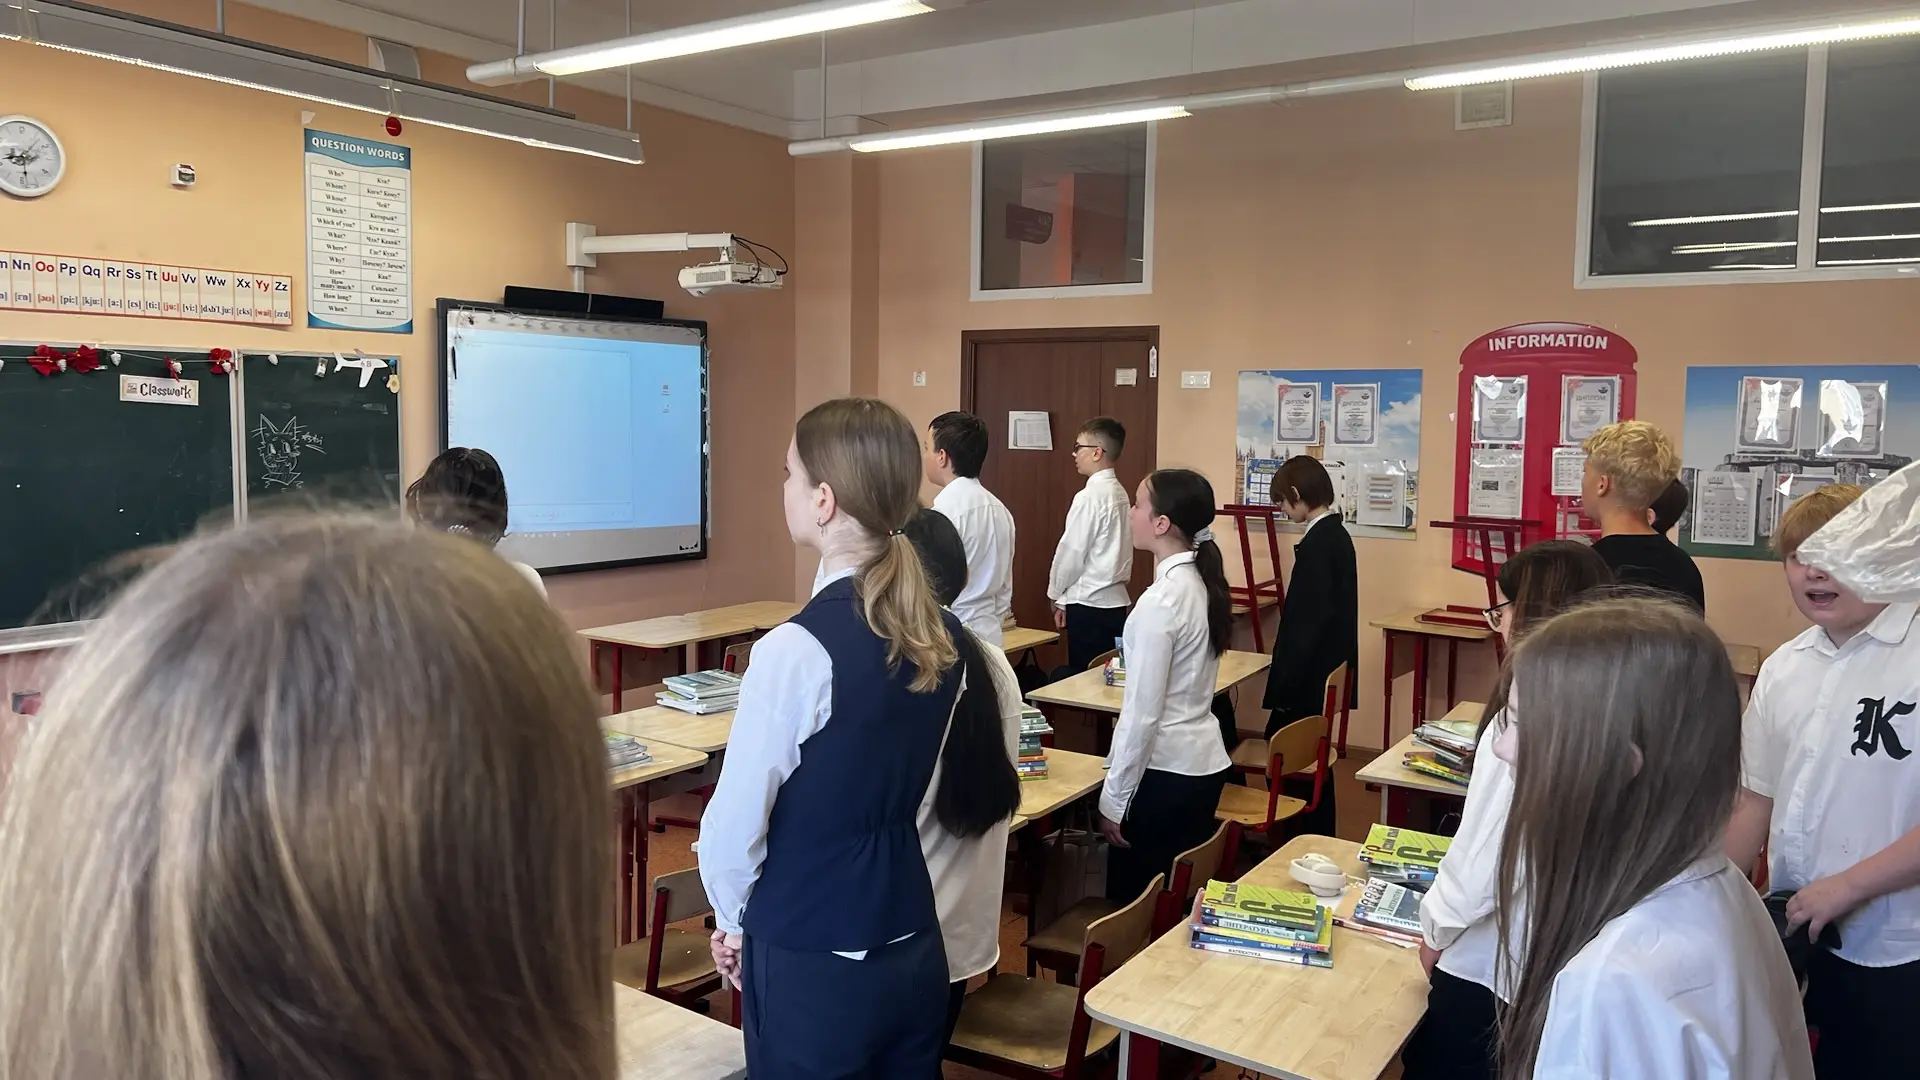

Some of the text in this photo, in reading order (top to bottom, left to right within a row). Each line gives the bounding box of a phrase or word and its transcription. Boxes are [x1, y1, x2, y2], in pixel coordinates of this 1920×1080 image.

[312, 137, 405, 161] QUESTION WORDS
[12, 259, 31, 271] Nn
[35, 261, 55, 273] Oo
[60, 262, 77, 276] Pp
[82, 265, 101, 279] Qq
[107, 266, 121, 278] Rr
[126, 269, 141, 280] Ss
[145, 270, 158, 281] Tt
[162, 271, 178, 282] Uu
[181, 273, 197, 284] Vv
[205, 275, 226, 286] Ww
[236, 278, 251, 289] Xx
[255, 279, 270, 292] Yy
[275, 281, 288, 292] Zz
[1488, 333, 1608, 351] INFORMATION
[140, 382, 192, 399] Classwork
[1850, 695, 1917, 761] K
[1224, 920, 1270, 934] ЛИТЕРАТУРА
